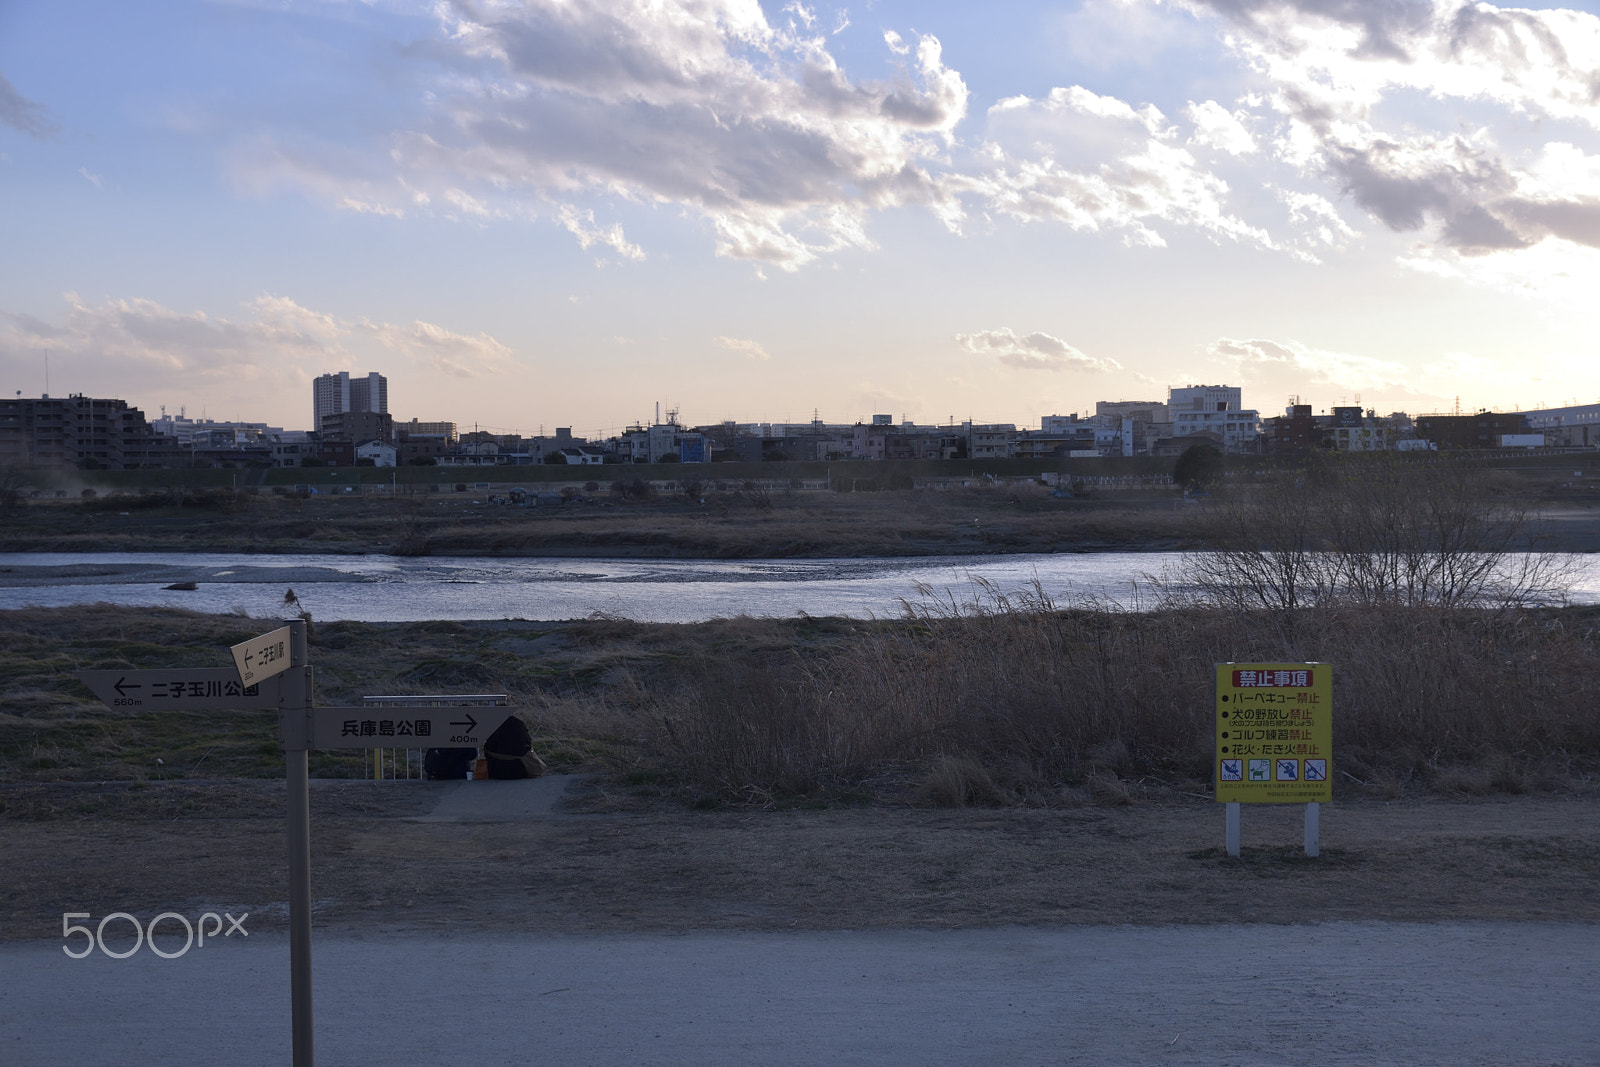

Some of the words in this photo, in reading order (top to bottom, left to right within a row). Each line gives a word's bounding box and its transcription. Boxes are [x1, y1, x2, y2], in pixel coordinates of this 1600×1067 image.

[1240, 670, 1308, 687] 禁止事項
[151, 681, 259, 698] 二子玉川公園
[113, 698, 142, 706] 560m
[1232, 692, 1320, 704] バーベキュー禁止
[1232, 708, 1313, 720] 犬の野放し禁止
[341, 719, 431, 737] 兵庫島公園
[450, 735, 478, 743] 400m
[1232, 729, 1313, 741] ゴルフ練習禁止
